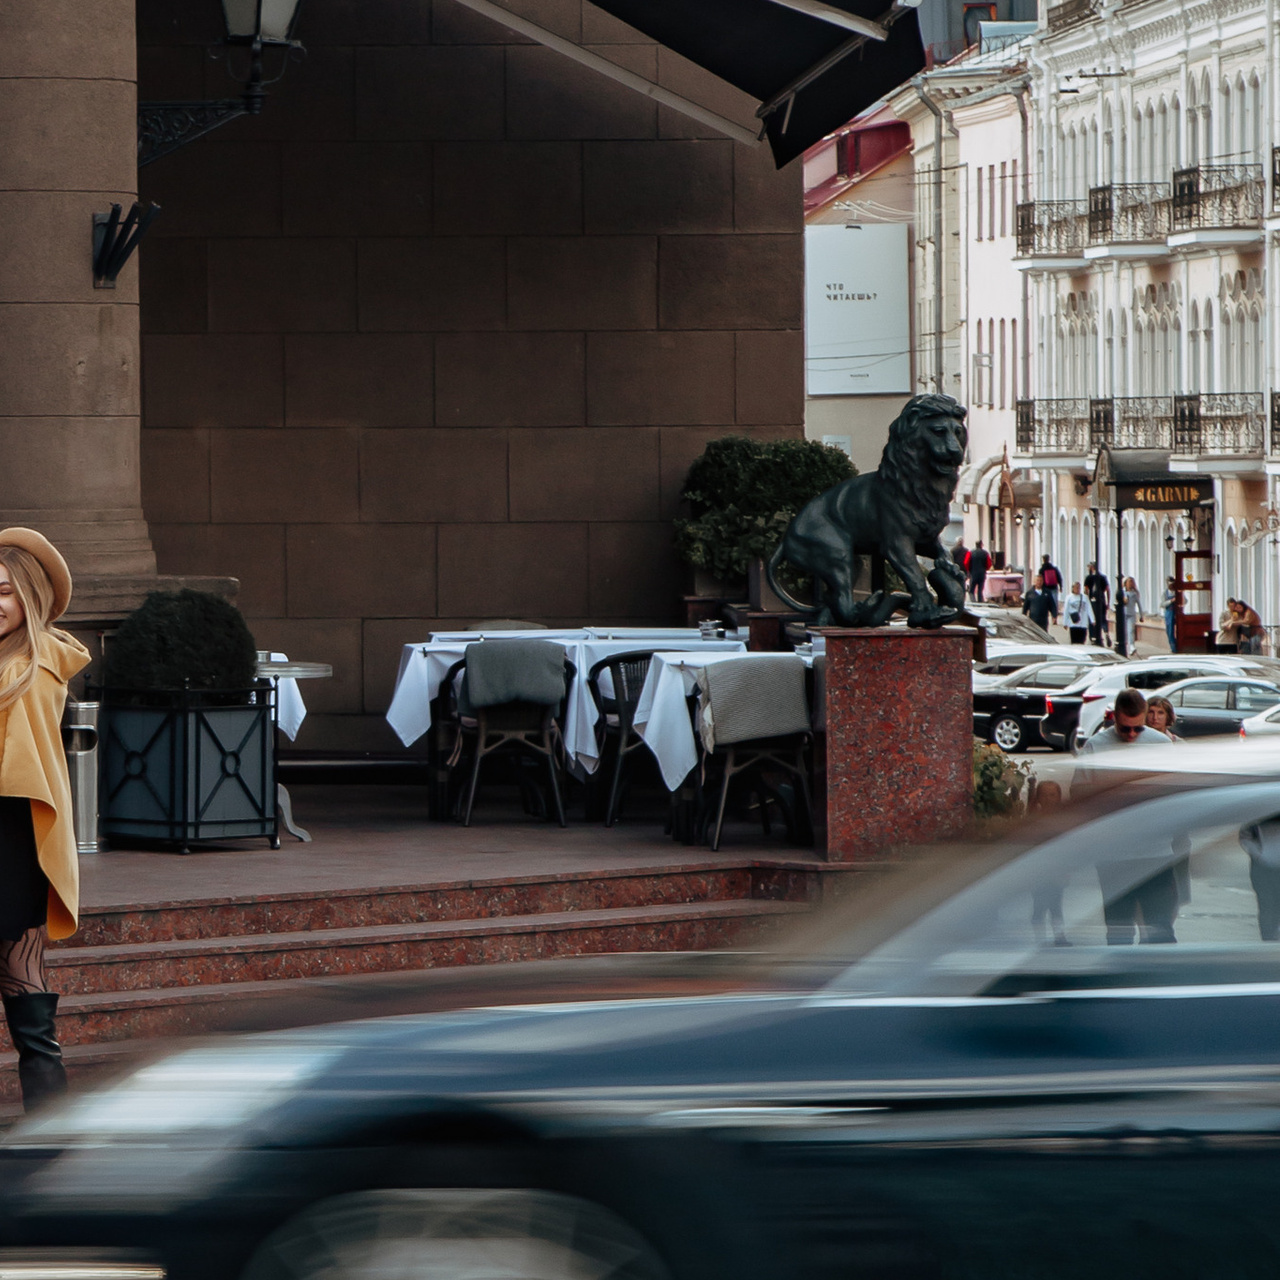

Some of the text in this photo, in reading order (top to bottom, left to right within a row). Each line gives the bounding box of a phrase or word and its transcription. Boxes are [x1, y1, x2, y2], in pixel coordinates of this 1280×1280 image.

[825, 283, 844, 291] ЧТО
[825, 293, 878, 301] ЧИТАЕШЬ?
[1146, 486, 1189, 502] GARNI
